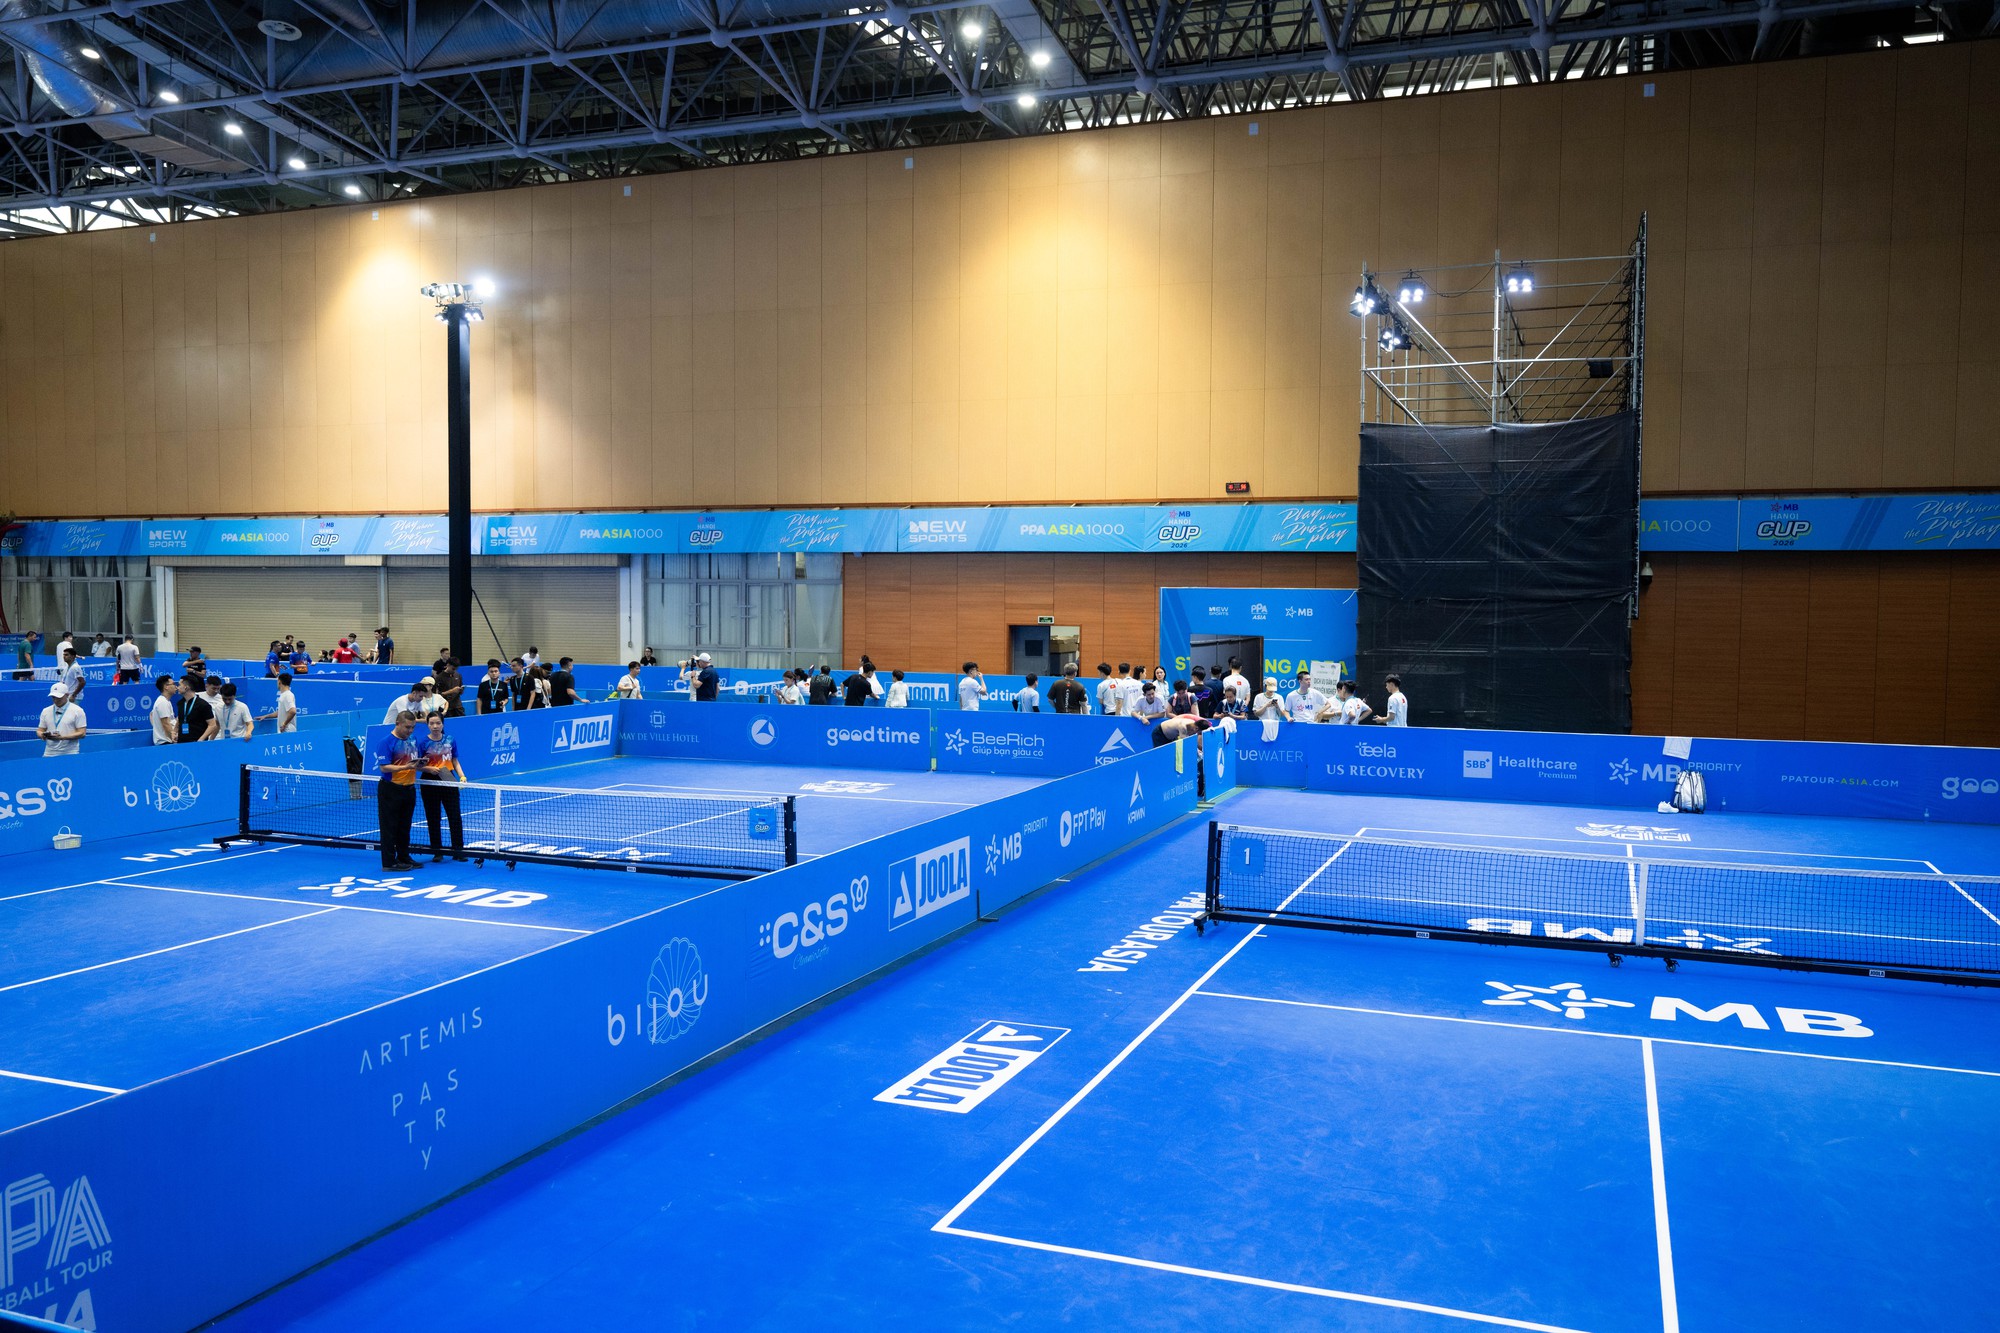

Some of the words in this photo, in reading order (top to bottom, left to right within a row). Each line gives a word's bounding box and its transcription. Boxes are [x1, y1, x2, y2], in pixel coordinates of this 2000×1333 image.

[1783, 503, 1799, 511] MB
[1912, 500, 1969, 520] Play
[785, 513, 819, 528] Play
[1278, 508, 1322, 525] Play
[1319, 512, 1347, 521] where
[390, 520, 417, 533] Play
[491, 526, 537, 537] NEW
[789, 526, 823, 541] Pros
[909, 520, 966, 533] NEW
[1158, 525, 1201, 542] CUP
[1272, 532, 1285, 542] the
[1284, 521, 1327, 540] Pros
[1757, 520, 1812, 539] CUP
[1920, 516, 1975, 536] Pros
[149, 530, 187, 540] NEW
[311, 533, 340, 547] CUP
[490, 538, 537, 546] SPORTS
[689, 529, 723, 544] CUP
[806, 532, 840, 550] play
[909, 534, 967, 543] SPORTS
[1305, 528, 1348, 549] play
[1947, 523, 2000, 547] play
[406, 536, 433, 552] play
[1251, 603, 1268, 613] PPA
[1298, 608, 1313, 617] MB
[90, 670, 104, 681] MB
[491, 723, 520, 747] PPA
[573, 719, 609, 745] JOOLA
[619, 732, 635, 741] MAY
[649, 733, 671, 741] VILLE
[673, 733, 700, 743] HOTEL
[972, 732, 1044, 747] BeeRich
[264, 742, 313, 756] ARTEMIS
[972, 746, 991, 756] Giúp
[994, 747, 1010, 757] bạn
[1033, 749, 1044, 757] có
[491, 752, 516, 766] ASIA
[1465, 759, 1487, 769] SBB
[1498, 755, 1577, 771] Healthcare
[1326, 764, 1344, 776] US
[1350, 765, 1425, 780] RECOVERY
[1538, 771, 1577, 780] Premium
[1641, 763, 1682, 783] MB
[1688, 761, 1742, 772] PRIORITY
[1781, 775, 1899, 788] PPATOUR-ASIA.COM
[123, 782, 200, 812] bijou
[262, 786, 269, 800] 2
[1073, 812, 1088, 837] FPT
[1089, 808, 1107, 831] Play
[1002, 831, 1022, 865] MB
[1024, 816, 1049, 836] PRIORITY
[1244, 847, 1251, 865] 1
[919, 848, 968, 908] JOOLA
[391, 884, 548, 908] MB
[772, 892, 849, 960] C&S
[607, 973, 708, 1046] bijou
[1650, 996, 1874, 1038] MB
[360, 1006, 482, 1074] ARTEMIS
[894, 1047, 1020, 1104] JOOLA
[60, 1250, 113, 1285] TOUR
